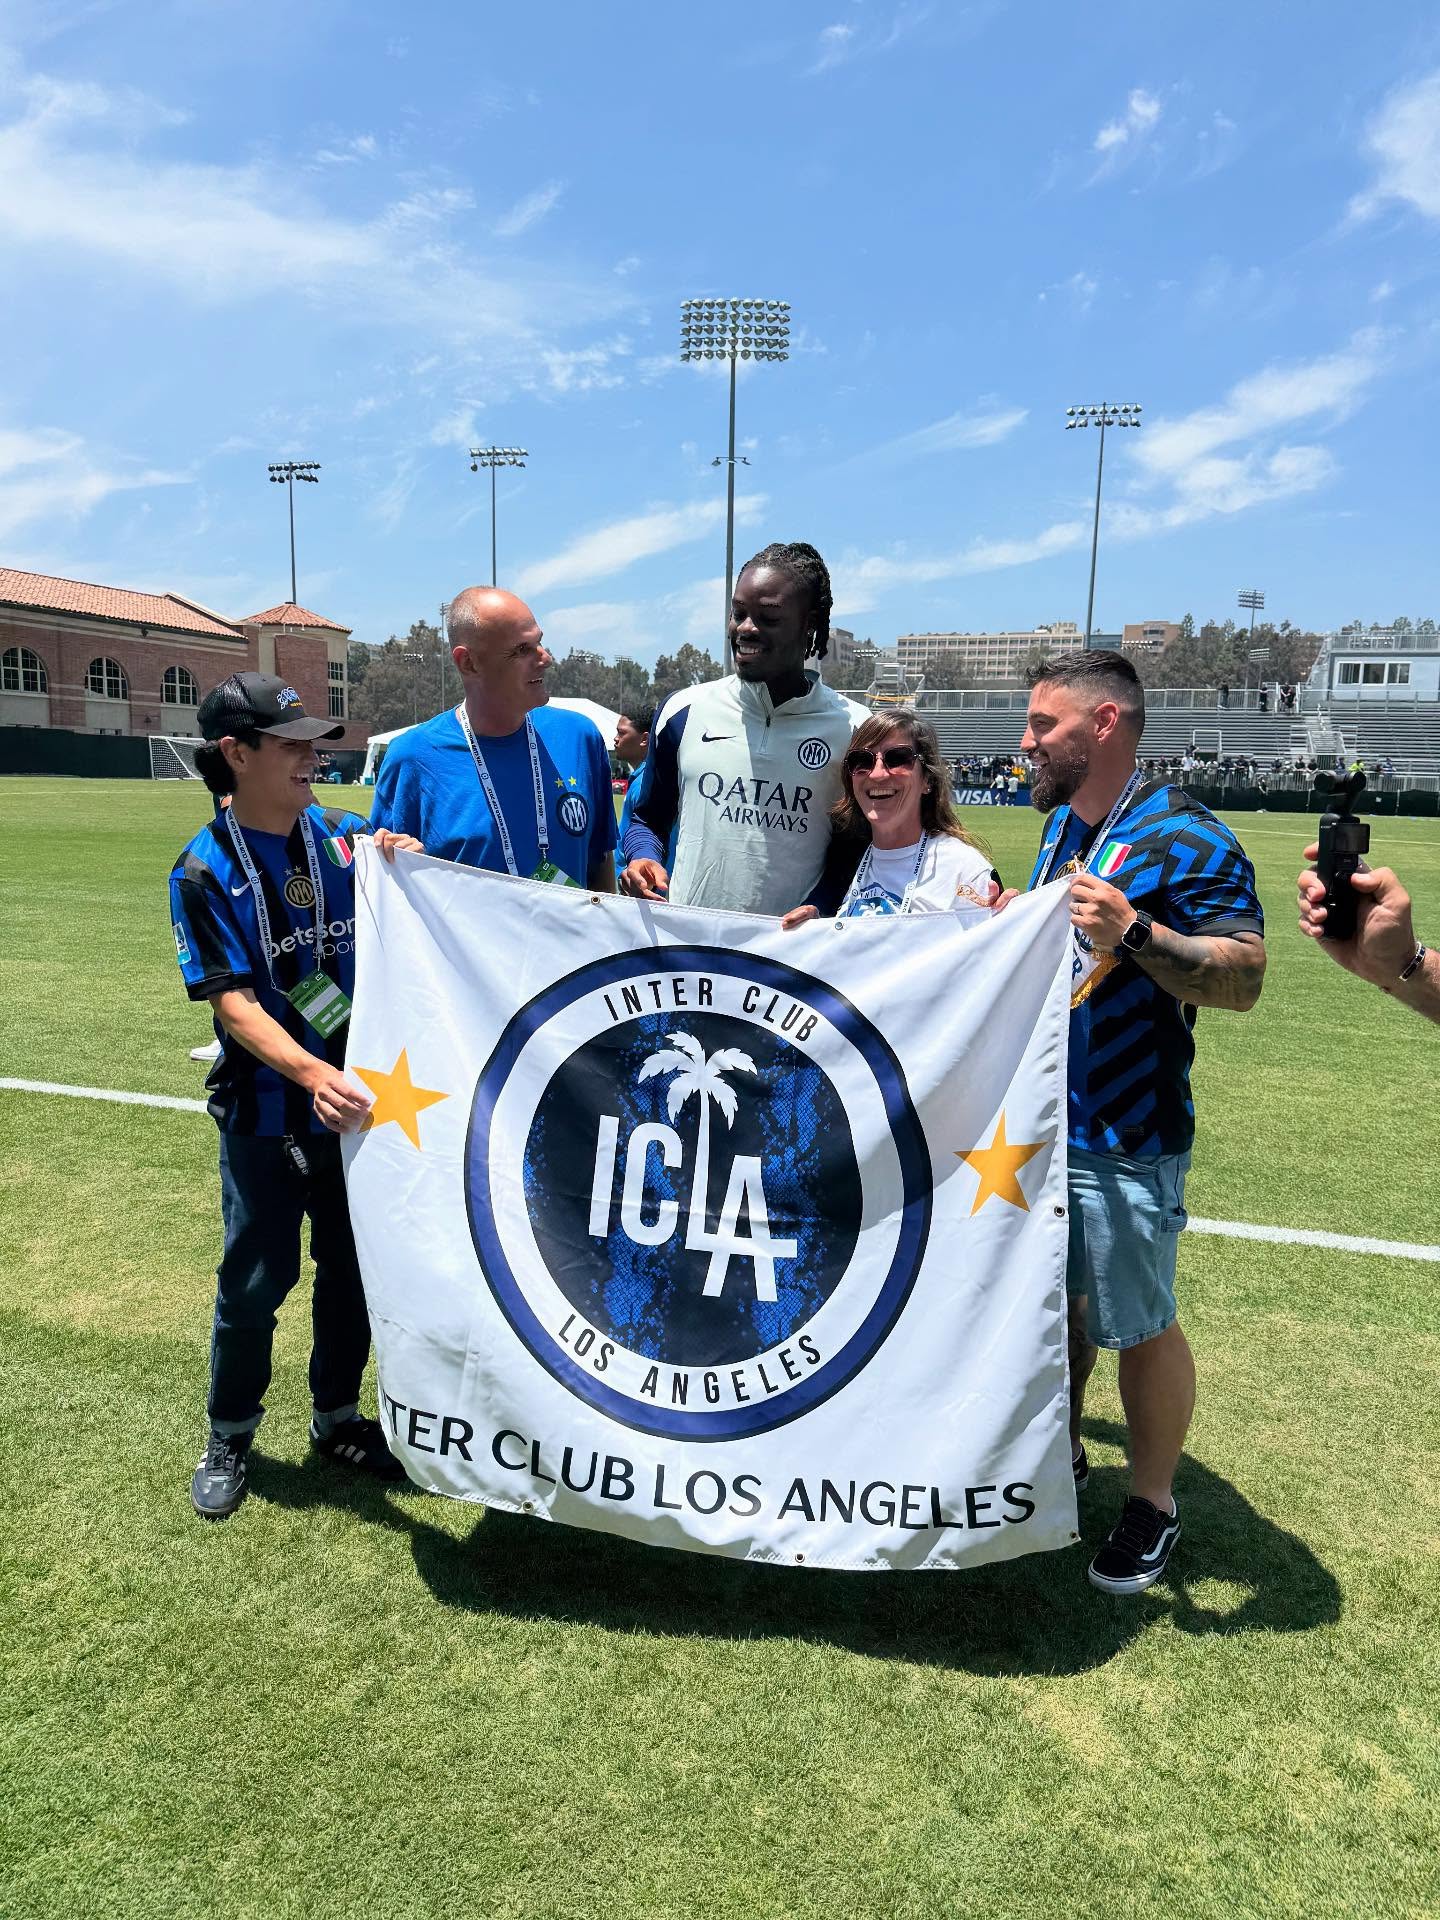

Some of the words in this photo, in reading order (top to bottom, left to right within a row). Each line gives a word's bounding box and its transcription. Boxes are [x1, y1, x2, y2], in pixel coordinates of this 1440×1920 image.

[699, 772, 813, 814] QATAR
[953, 789, 993, 805] VISA
[1116, 791, 1129, 809] WORLD
[719, 805, 808, 834] AIRWAYS
[1110, 809, 1119, 820] CUP
[604, 977, 713, 1021] INTER
[742, 985, 819, 1042] CLUB
[588, 1098, 798, 1302] ICLA
[558, 1314, 615, 1372] LOS
[640, 1335, 821, 1405] ANGELES
[491, 1429, 635, 1501] CLUB
[653, 1463, 762, 1517] LOS
[776, 1477, 1035, 1530] ANGELES
